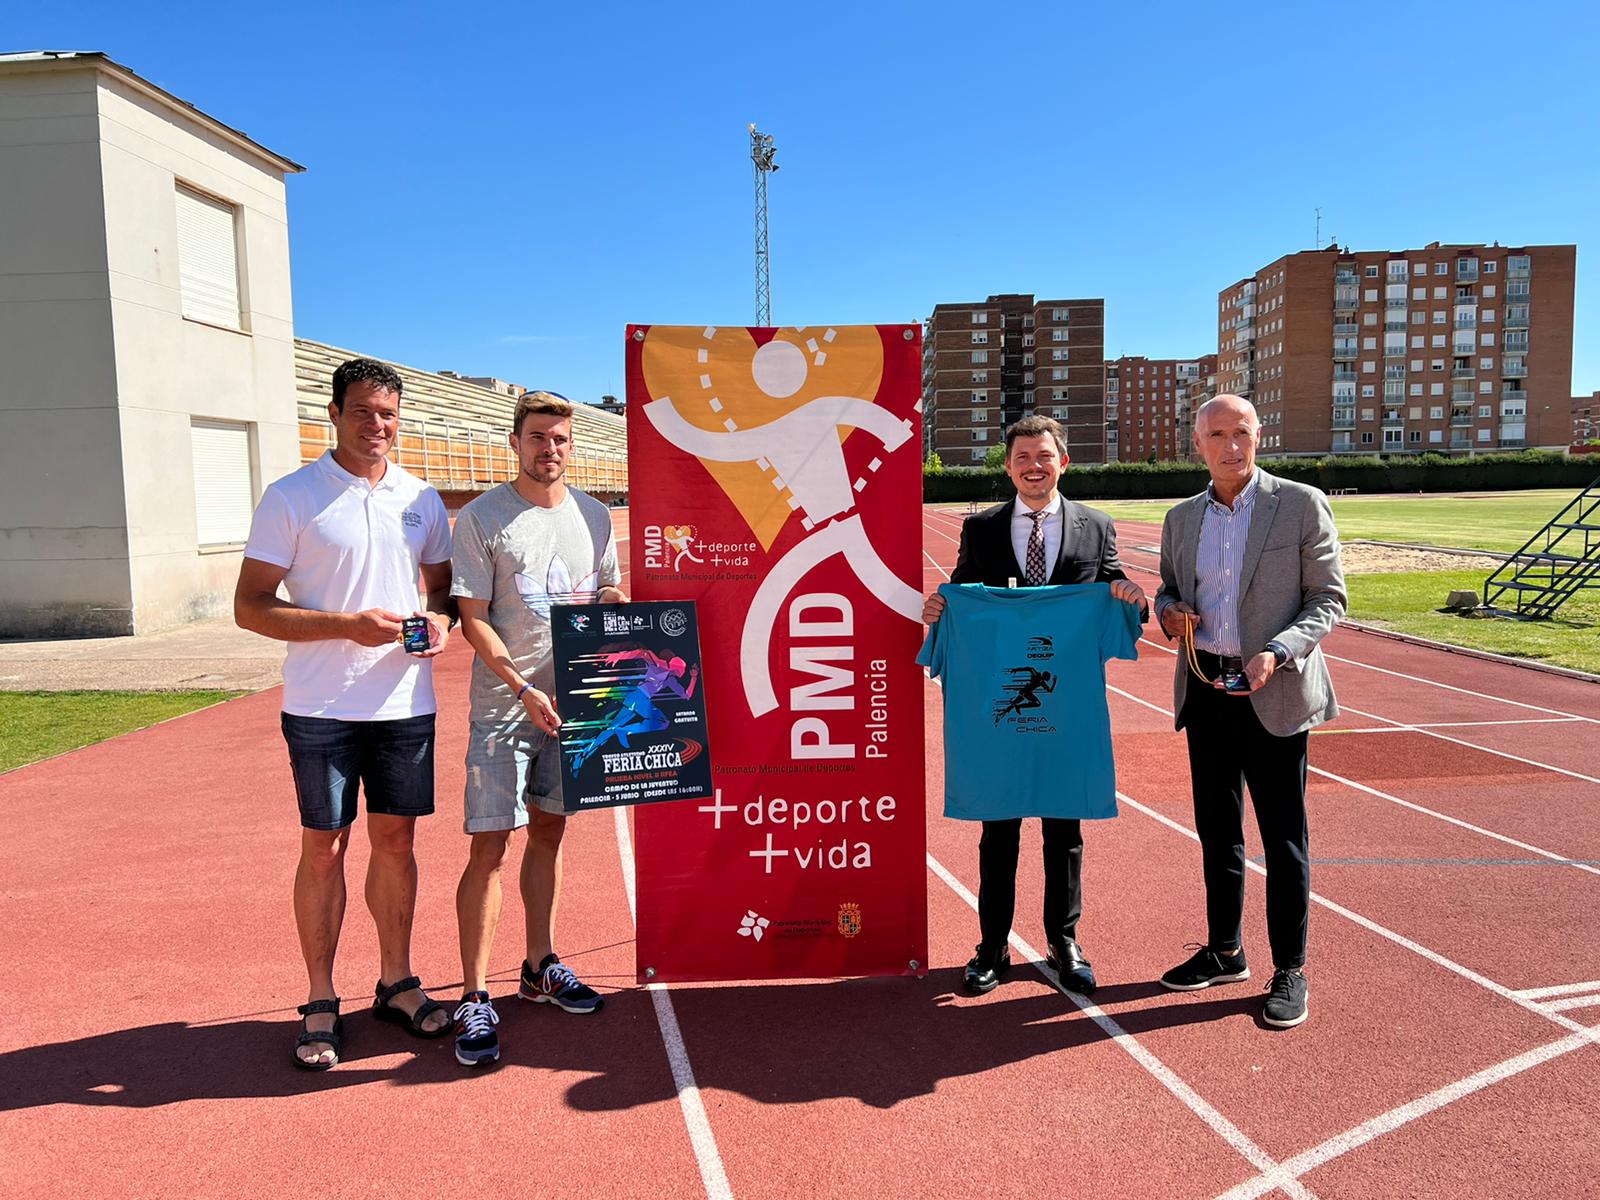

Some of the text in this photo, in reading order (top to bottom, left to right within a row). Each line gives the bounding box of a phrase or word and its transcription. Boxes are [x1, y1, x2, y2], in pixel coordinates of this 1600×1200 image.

[645, 525, 662, 568] PMD
[726, 572, 756, 581] Deportes
[789, 592, 855, 759] PMD
[865, 659, 888, 758] Palencia
[648, 743, 675, 753] XXXIV
[604, 752, 682, 774] FERIA CHICA
[714, 763, 857, 775] Patronato Municipal de Deportes
[604, 784, 630, 793] CAMPO
[649, 780, 679, 789] JUVENTUD
[580, 794, 611, 804] PALENCIA
[620, 792, 640, 800] JUNIO
